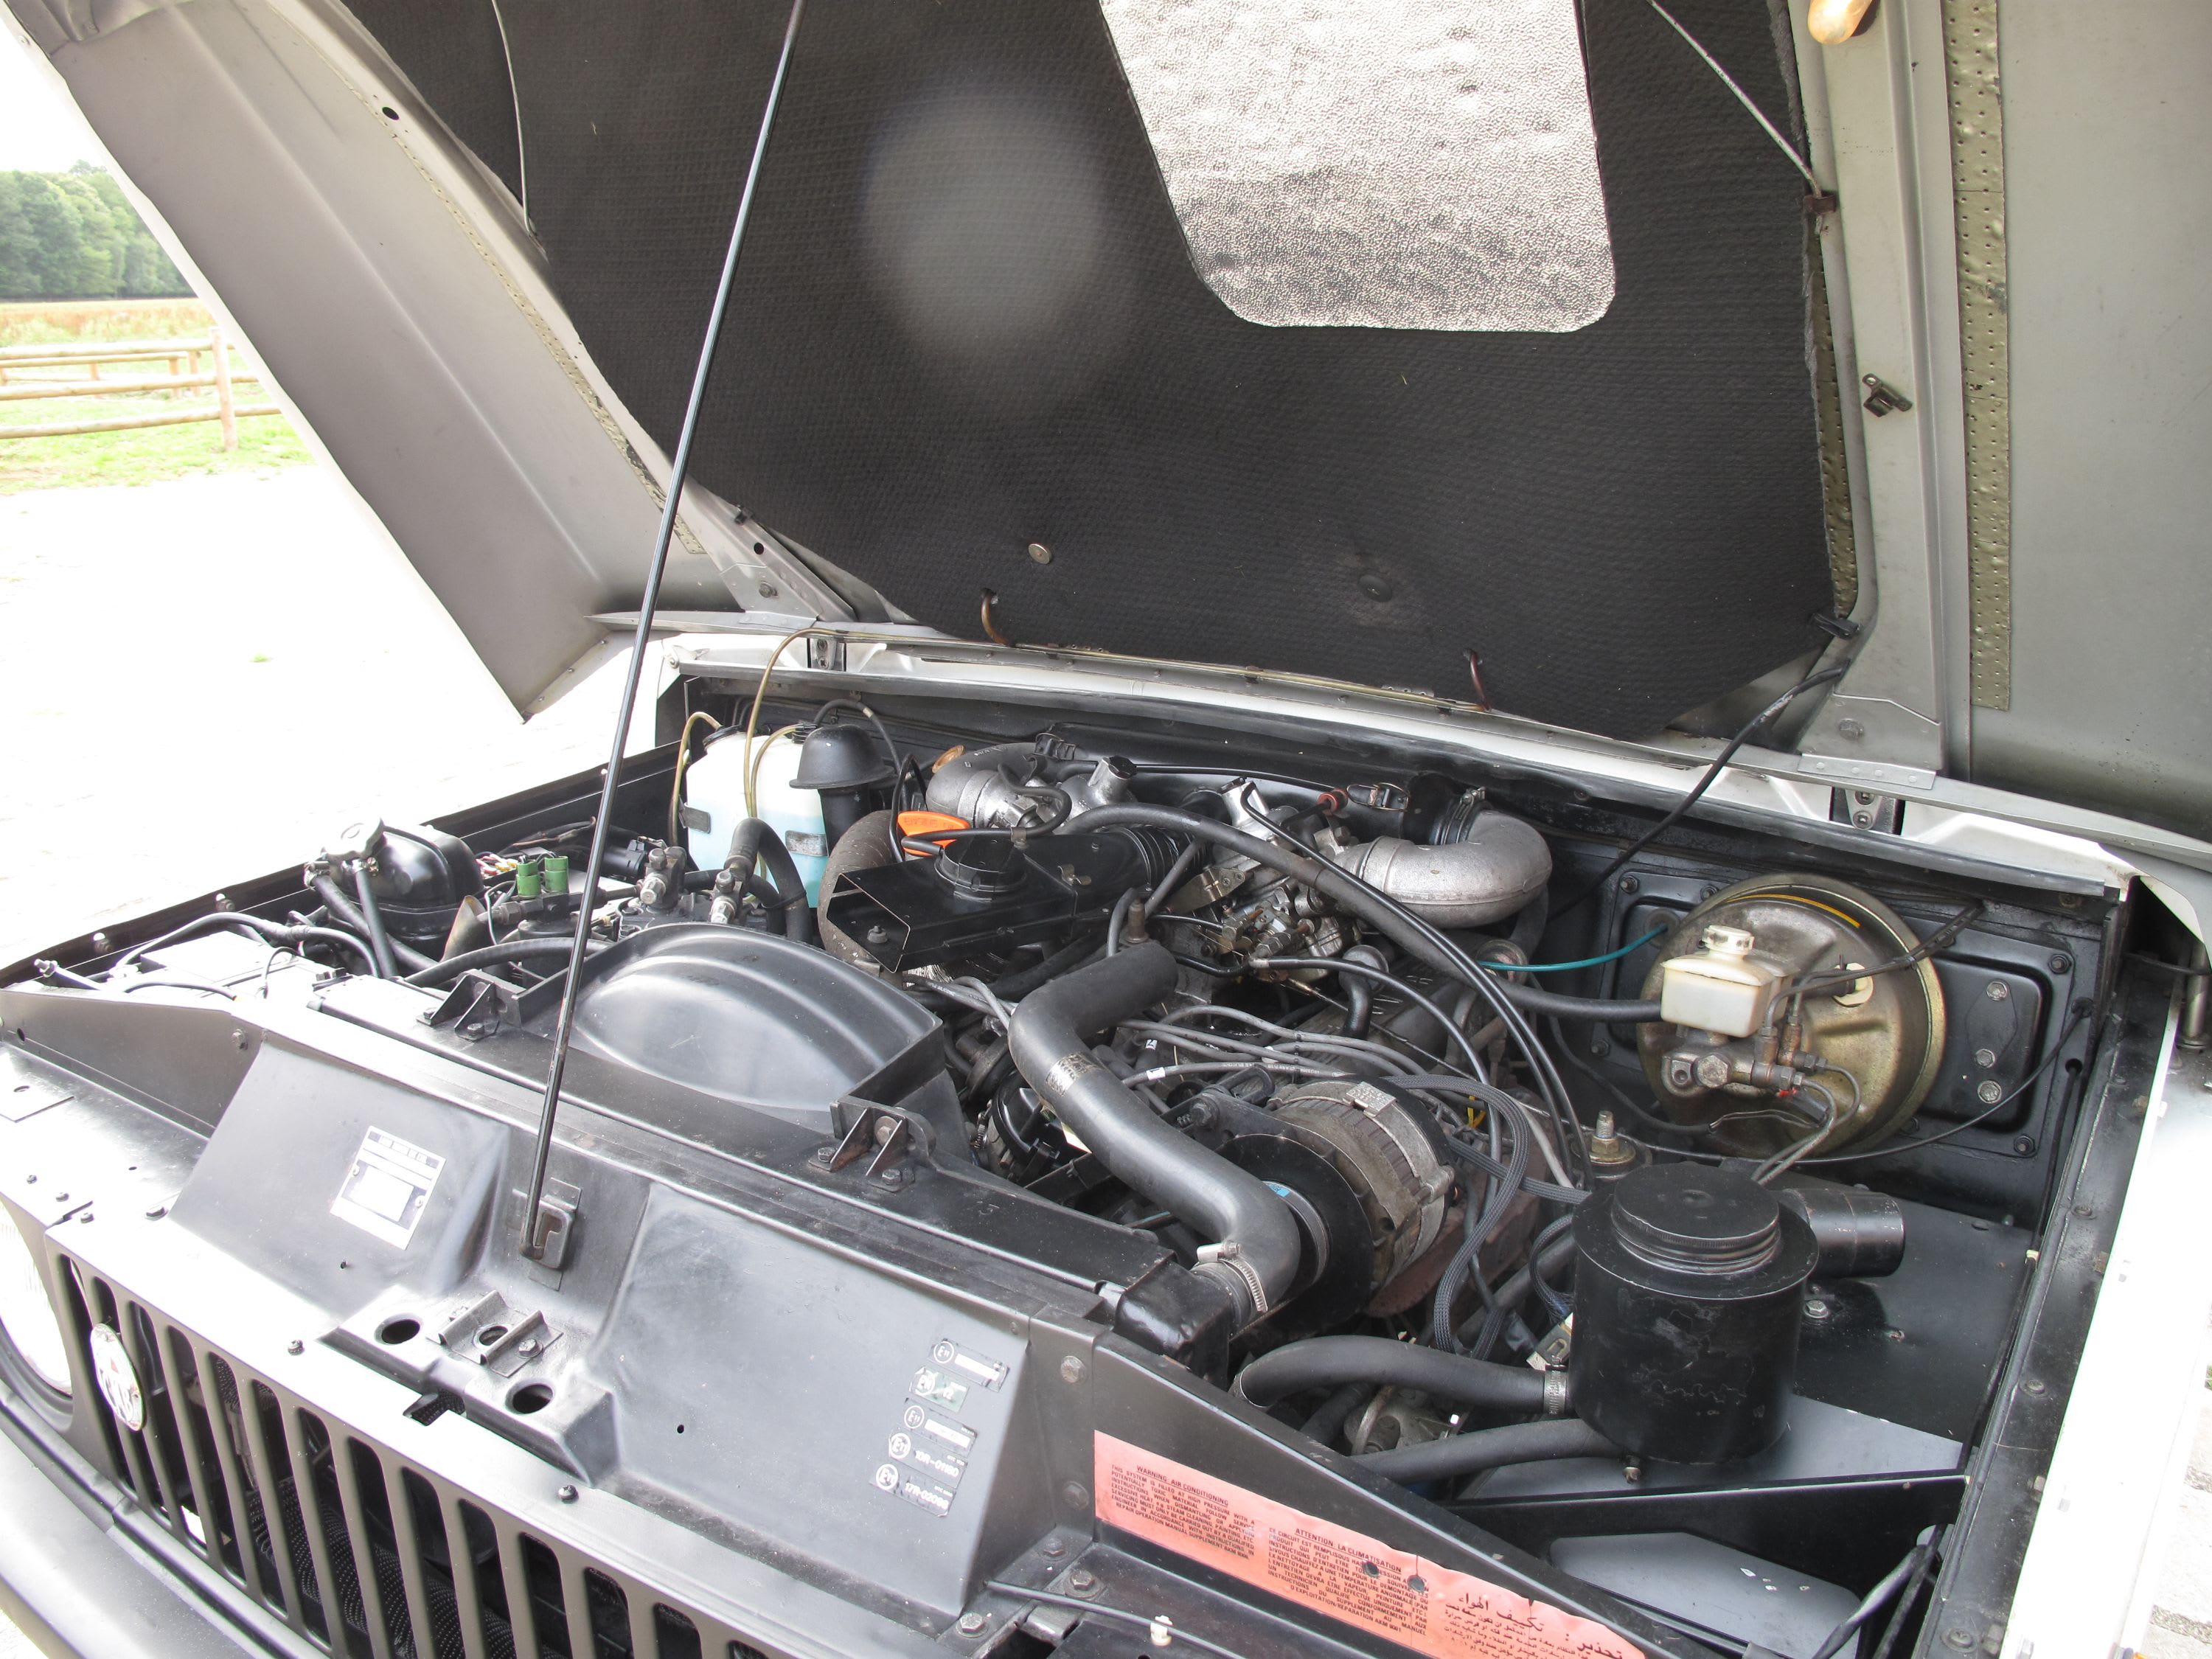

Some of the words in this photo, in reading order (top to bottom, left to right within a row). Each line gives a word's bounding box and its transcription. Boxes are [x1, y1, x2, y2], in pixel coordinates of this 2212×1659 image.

[1111, 1470, 1144, 1487] POTENTIALLY
[1152, 1486, 1166, 1496] TOXIC
[1206, 1508, 1226, 1520] FOLLOW
[1111, 1476, 1148, 1495] INSTRUCTIONS
[1154, 1493, 1169, 1503] WHEN
[1175, 1501, 1211, 1520] DISMANTLING
[1111, 1482, 1137, 1497] EXCESSIVE
[1166, 1504, 1184, 1515] STEAM
[1112, 1464, 1122, 1473] THIS
[1126, 1470, 1147, 1483] SYSTEM
[1158, 1483, 1174, 1493] FILLED
[1188, 1495, 1200, 1503] HIGH
[1203, 1500, 1229, 1515] PRESSURE
[1234, 1512, 1247, 1522] WITH
[1171, 1478, 1181, 1487] AIR
[1183, 1483, 1228, 1506] CONDITIONING
[1111, 1488, 1138, 1503] SERVICING
[1140, 1499, 1154, 1509] MUST
[1155, 1506, 1169, 1515] ONLY
[1179, 1515, 1200, 1528] CARRIED
[1202, 1524, 1211, 1532] OUT
[1228, 1534, 1253, 1549] QUALIFIED
[1111, 1494, 1136, 1508] ENGINEER
[1150, 1509, 1183, 1527] ACCORDANCE
[1189, 1525, 1202, 1534] WITH
[1206, 1532, 1243, 1551] INSTRUCTIONS
[1116, 1501, 1133, 1513] REPAIR
[1135, 1509, 1163, 1525] OPERATION
[1165, 1521, 1186, 1534] MANUAL
[1189, 1531, 1222, 1548] SUPPLEMENT
[1278, 1530, 1299, 1543] CIRCUIT
[1301, 1539, 1310, 1548] EST
[1269, 1539, 1310, 1560] INSTRUCTIONS
[1352, 1571, 1367, 1582] POUR
[1380, 1581, 1416, 1601] DEMONTAGE
[1420, 1596, 1427, 1604] OU
[1299, 1545, 1309, 1554] QUI
[1315, 1551, 1329, 1561] PEUT
[1335, 1558, 1349, 1568] ETRE
[1338, 1543, 1345, 1551] LA
[1268, 1563, 1276, 1571] UN
[1284, 1570, 1317, 1587] TECHNICIEN
[1357, 1598, 1405, 1621] CONFORMEMENT
[1414, 1620, 1426, 1630] AUX
[1268, 1569, 1308, 1590] INSTRUCTIONS
[1318, 1589, 1326, 1597] DU
[1336, 1596, 1374, 1615] SUPPLEMENT
[1383, 1614, 1391, 1622] AU
[1401, 1621, 1425, 1635] MANUEL
[1291, 1554, 1318, 1569] CHAUFFEZ
[1325, 1567, 1335, 1576] UNE
[1338, 1571, 1378, 1593] TEMPERATURE
[1380, 1587, 1411, 1605] ANORMALE
[1306, 1572, 1324, 1584] DEVRA
[1327, 1580, 1340, 1590] ETRE
[1374, 1597, 1411, 1618] UNIQUEMENT
[1415, 1613, 1427, 1624] PAR
[1376, 1592, 1402, 1608] PEINTURE
